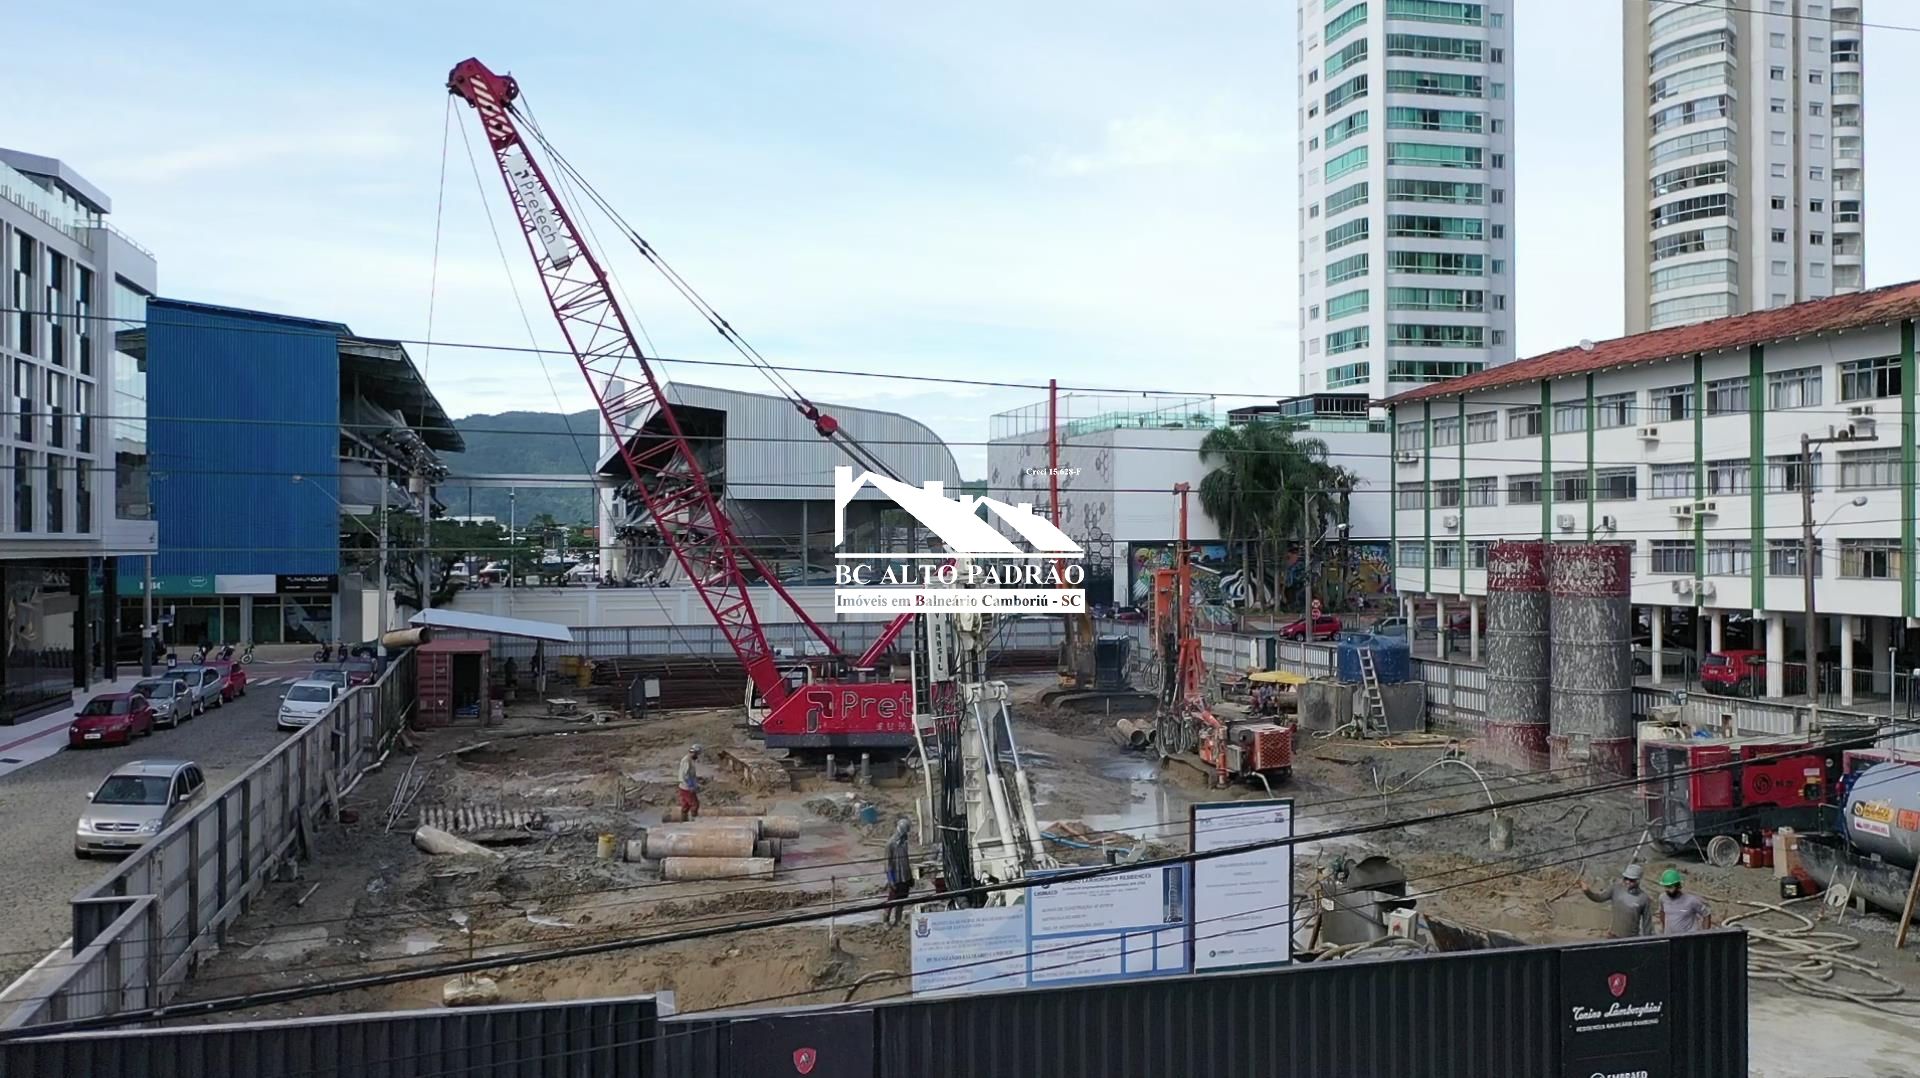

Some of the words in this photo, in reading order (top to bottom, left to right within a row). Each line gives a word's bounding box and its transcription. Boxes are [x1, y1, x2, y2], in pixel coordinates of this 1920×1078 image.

[519, 180, 557, 245] Pretech
[841, 690, 913, 720] Pret
[1572, 1006, 1602, 1021] Tonino
[1603, 1001, 1663, 1018] Lamborghini
